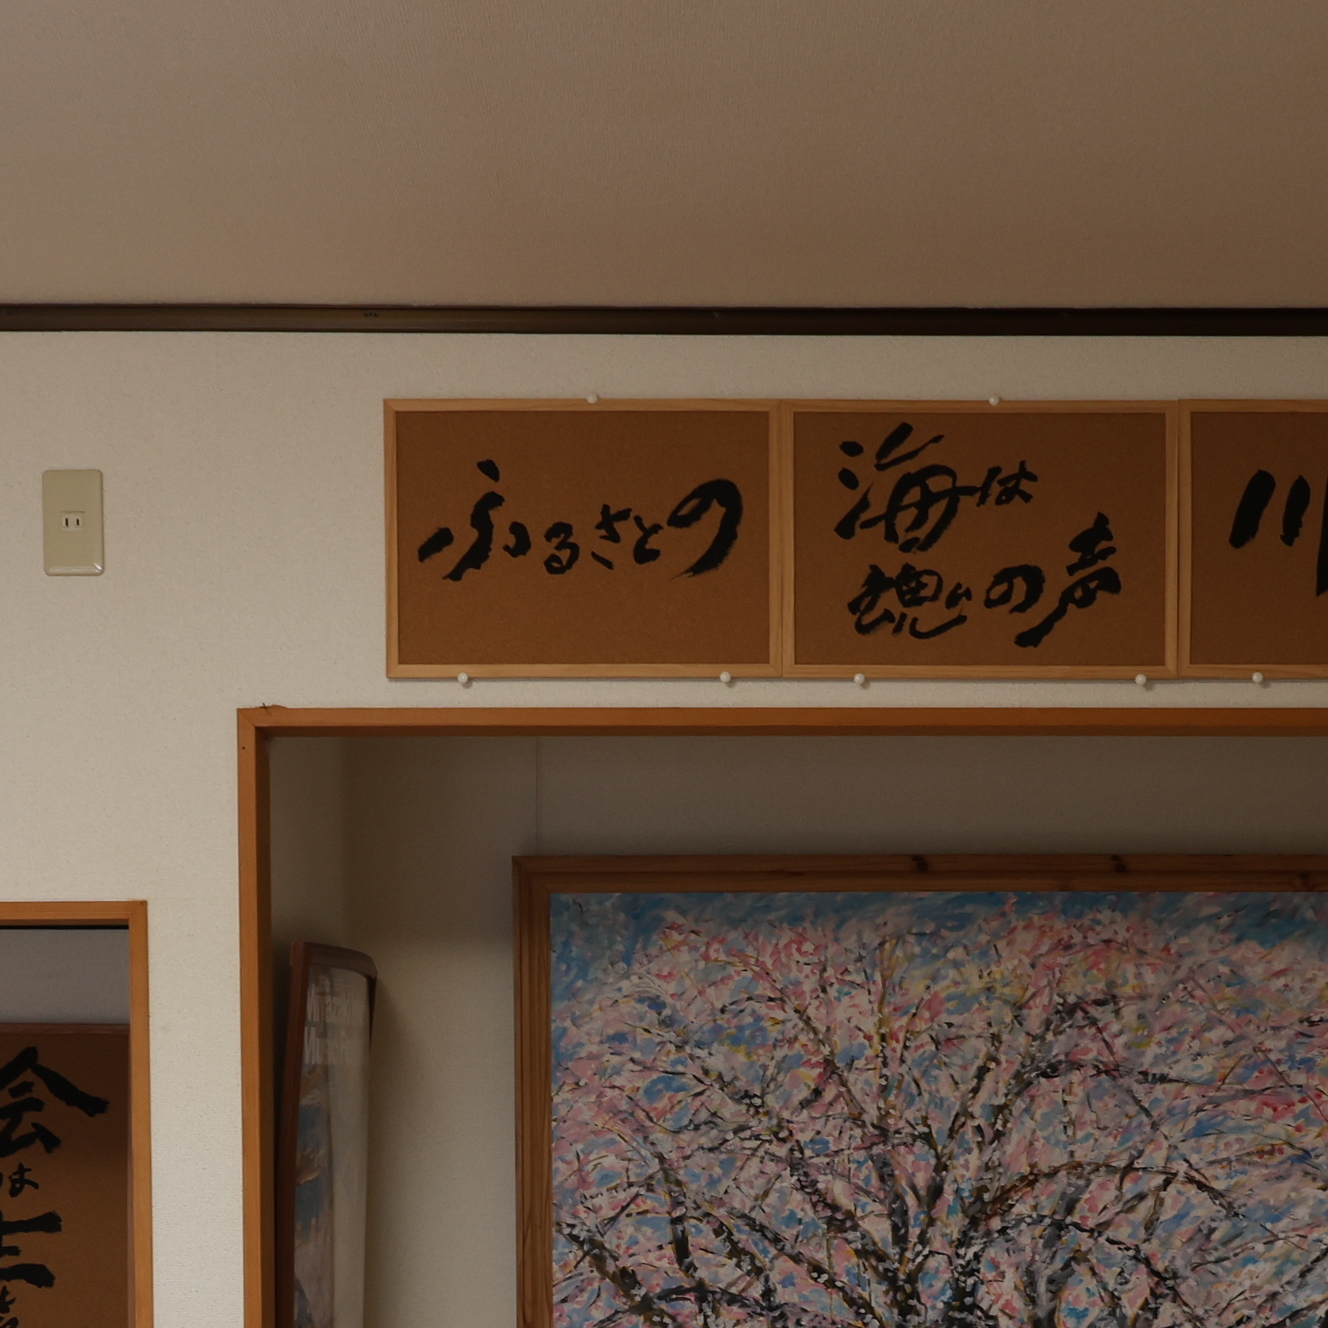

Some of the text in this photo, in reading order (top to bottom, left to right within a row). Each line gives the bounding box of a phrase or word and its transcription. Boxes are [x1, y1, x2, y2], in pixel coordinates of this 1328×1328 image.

[418, 461, 744, 580] ふるさとの
[833, 421, 1039, 553] 海は
